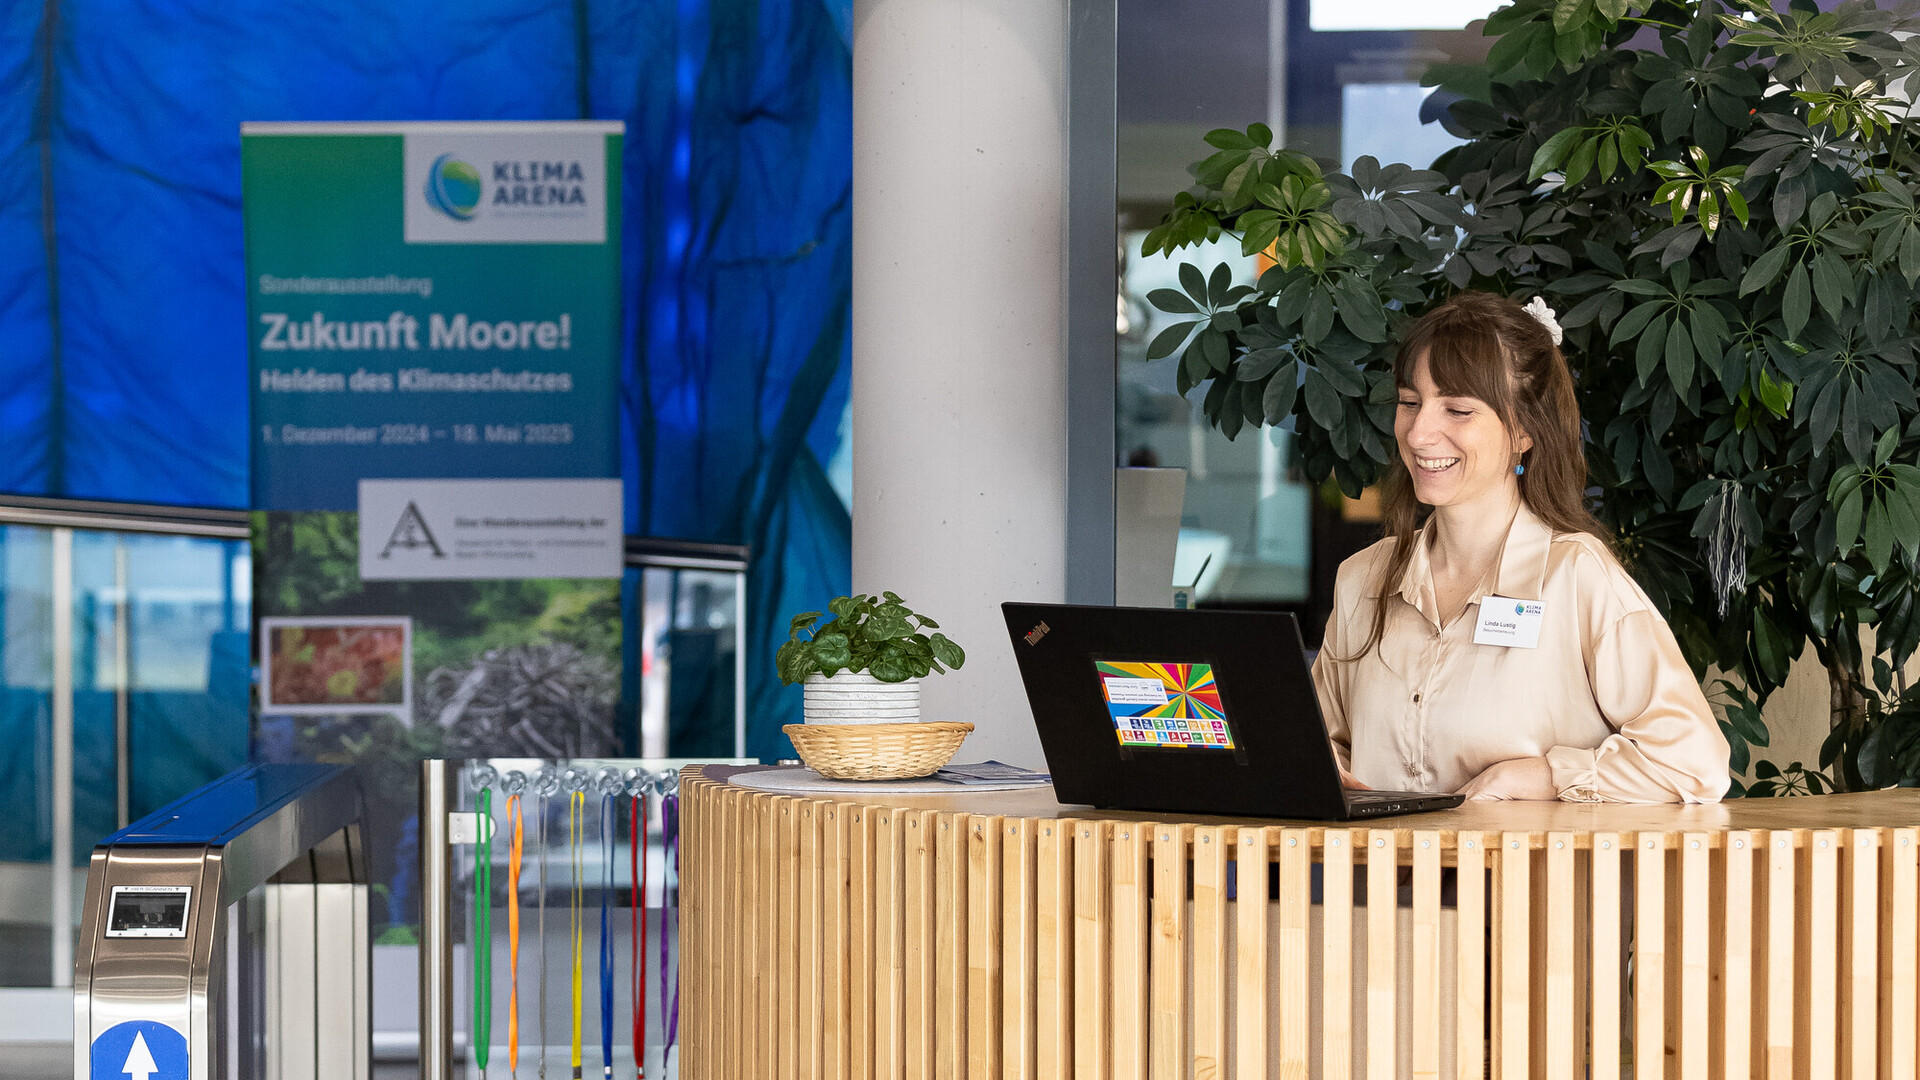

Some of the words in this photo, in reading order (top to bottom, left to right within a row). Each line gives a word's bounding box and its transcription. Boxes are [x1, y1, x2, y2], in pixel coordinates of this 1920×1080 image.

[493, 161, 584, 182] KLIMA
[493, 185, 586, 206] ARENA
[259, 275, 432, 298] Sonderausstellung
[260, 311, 419, 350] Zukunft
[429, 313, 571, 350] Moore!
[260, 368, 345, 392] Helden
[350, 368, 393, 392] des
[398, 368, 573, 392] Klimaschutzes
[282, 423, 378, 445] Dezember
[484, 423, 521, 444] Mai
[1024, 620, 1051, 646] ThinkPad
